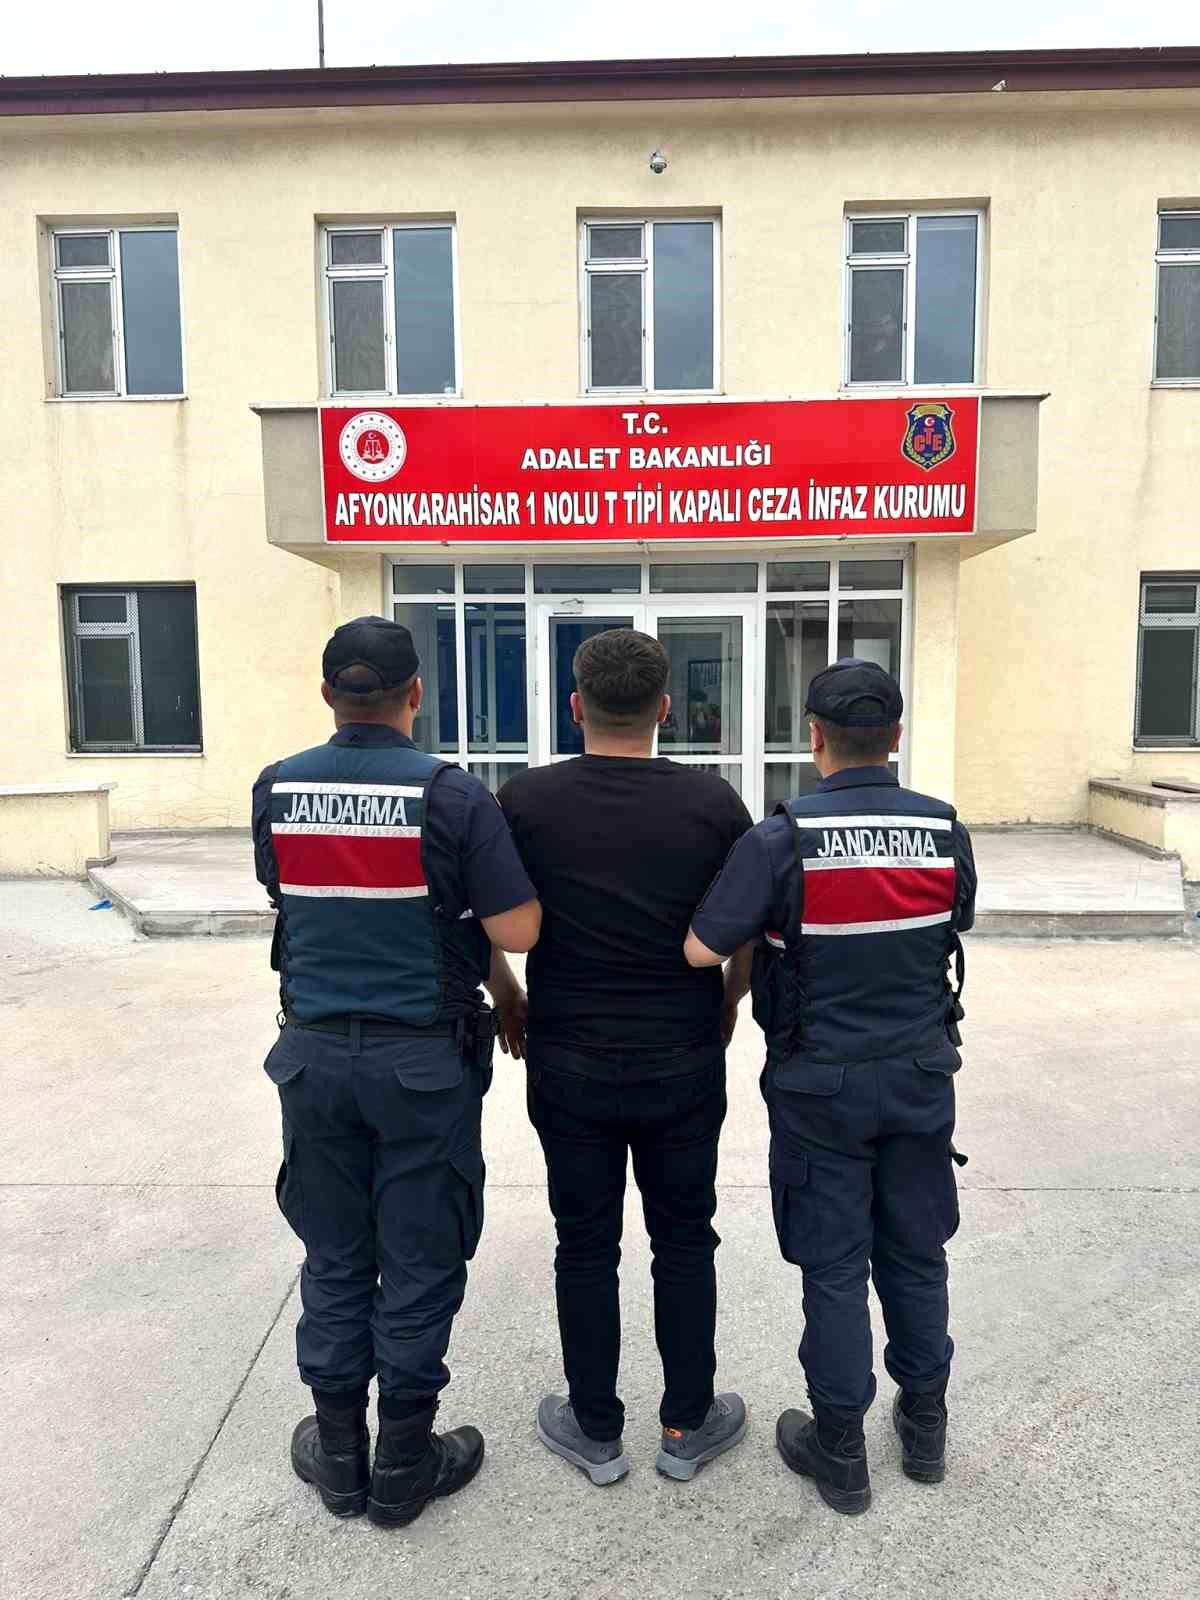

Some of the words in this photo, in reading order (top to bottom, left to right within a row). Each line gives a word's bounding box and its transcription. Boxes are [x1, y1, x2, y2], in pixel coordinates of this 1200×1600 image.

[622, 412, 669, 435] T.C.
[521, 448, 621, 470] ADALET
[629, 440, 772, 469] BAKANLIĞI
[335, 484, 521, 526] AFYONKARAHİSAR
[526, 491, 536, 525] 1
[544, 490, 599, 525] NOLU
[605, 490, 617, 524] T
[623, 482, 662, 524] TİPİ
[669, 488, 742, 523] KAPALI
[748, 487, 802, 521] CEZA
[808, 478, 868, 520] İNFAZ
[873, 483, 967, 519] KURUMU
[283, 793, 408, 825] JANDARMA
[816, 829, 938, 857] JANDARMA
